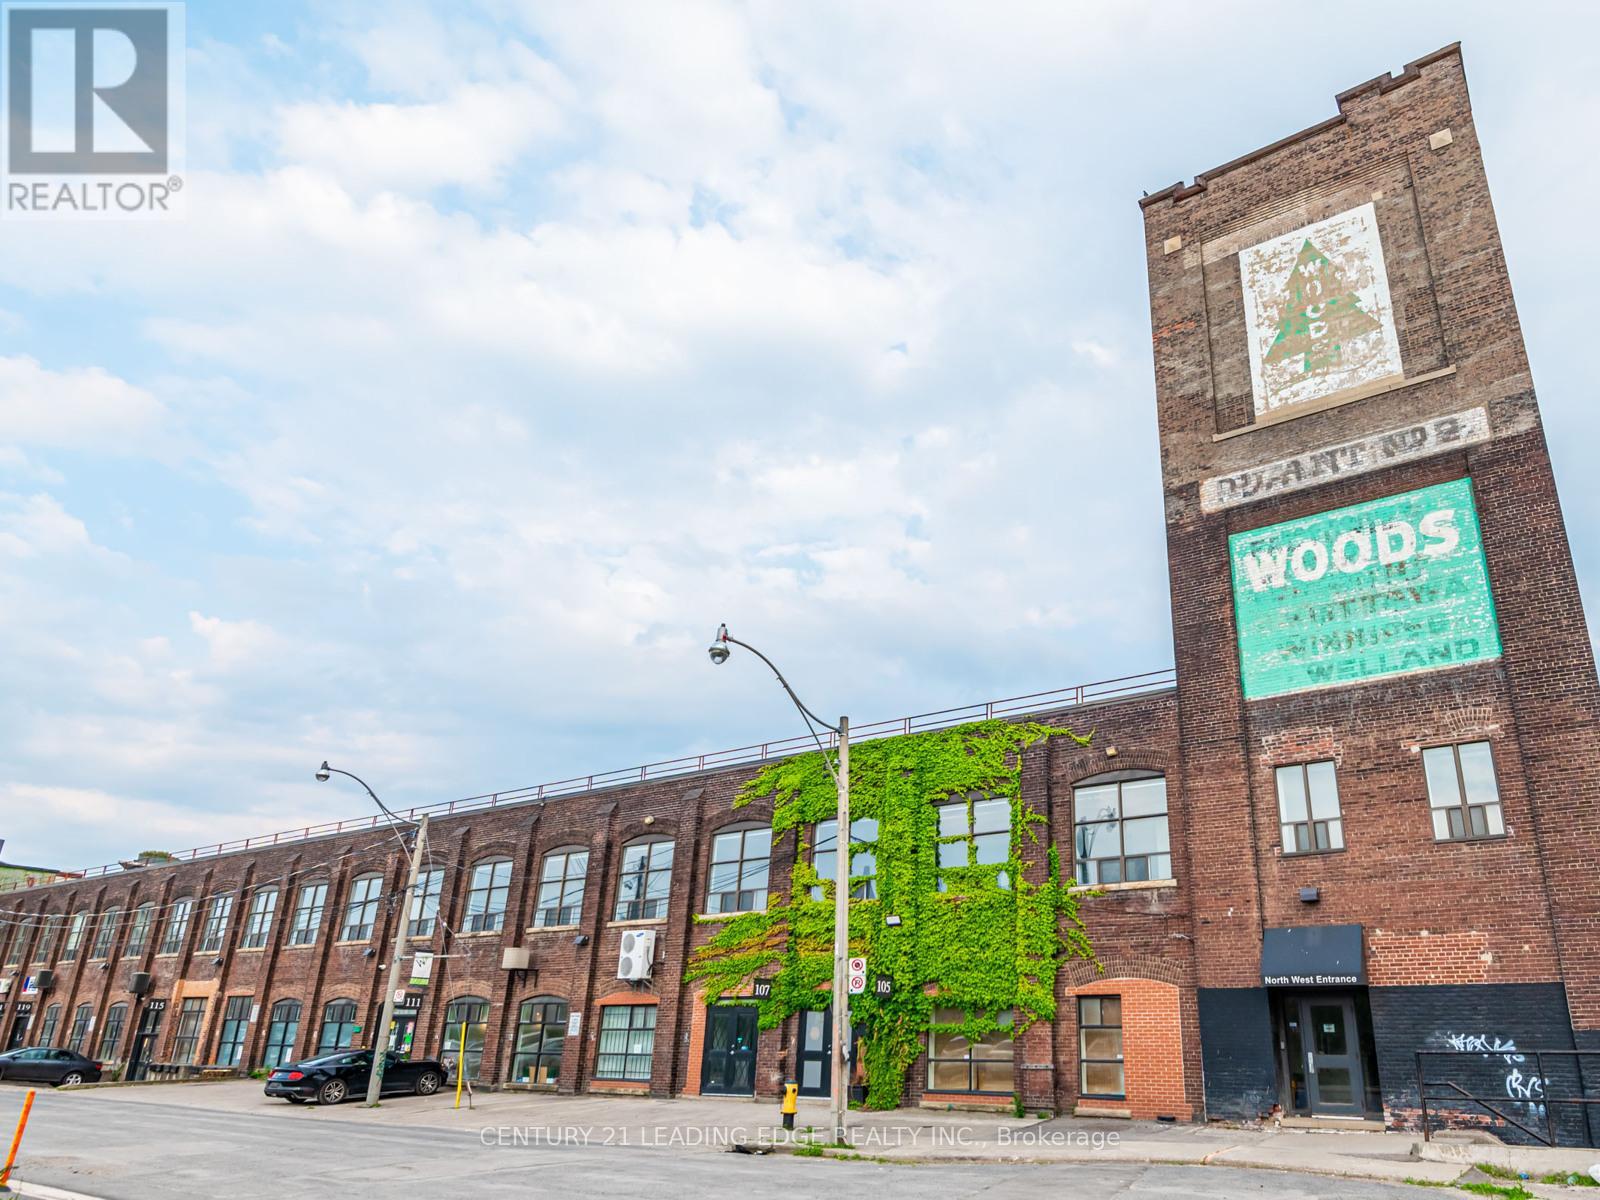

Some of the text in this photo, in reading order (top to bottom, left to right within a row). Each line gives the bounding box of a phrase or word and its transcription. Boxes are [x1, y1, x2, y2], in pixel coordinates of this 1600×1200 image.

[1244, 508, 1460, 593] WOODS
[1307, 638, 1480, 683] WELLAND
[1265, 975, 1357, 984] North West Entrance
[755, 984, 770, 996] 107
[877, 980, 891, 993] 105
[17, 1003, 31, 1011] 119
[150, 1001, 165, 1010] 115
[406, 998, 420, 1007] 111
